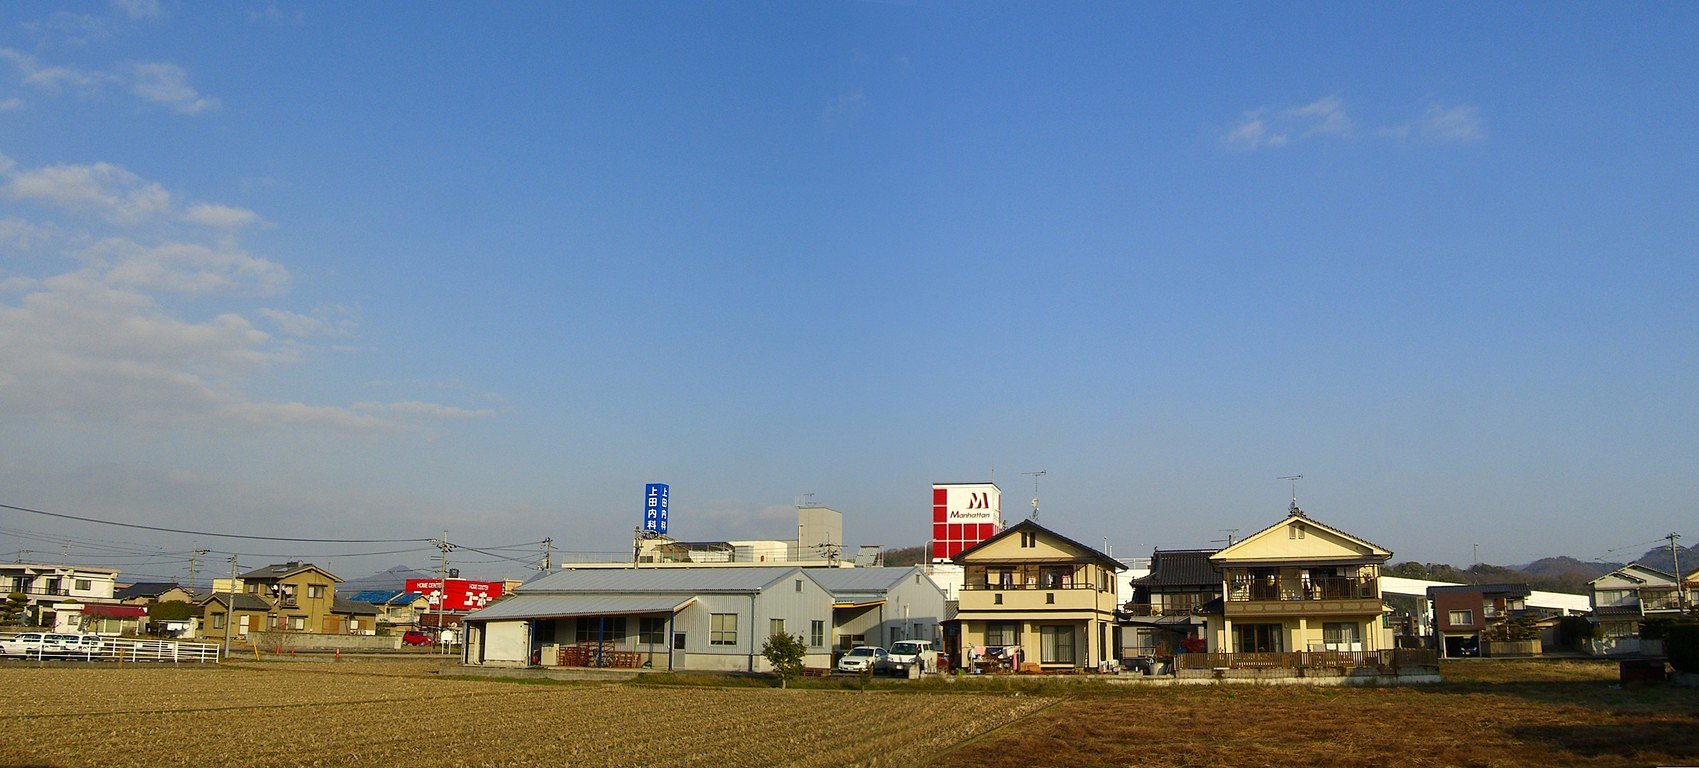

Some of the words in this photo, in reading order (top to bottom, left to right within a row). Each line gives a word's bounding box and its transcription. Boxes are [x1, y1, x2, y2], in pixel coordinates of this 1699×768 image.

[647, 486, 658, 530] 上田内科
[950, 510, 991, 519] Manhattan
